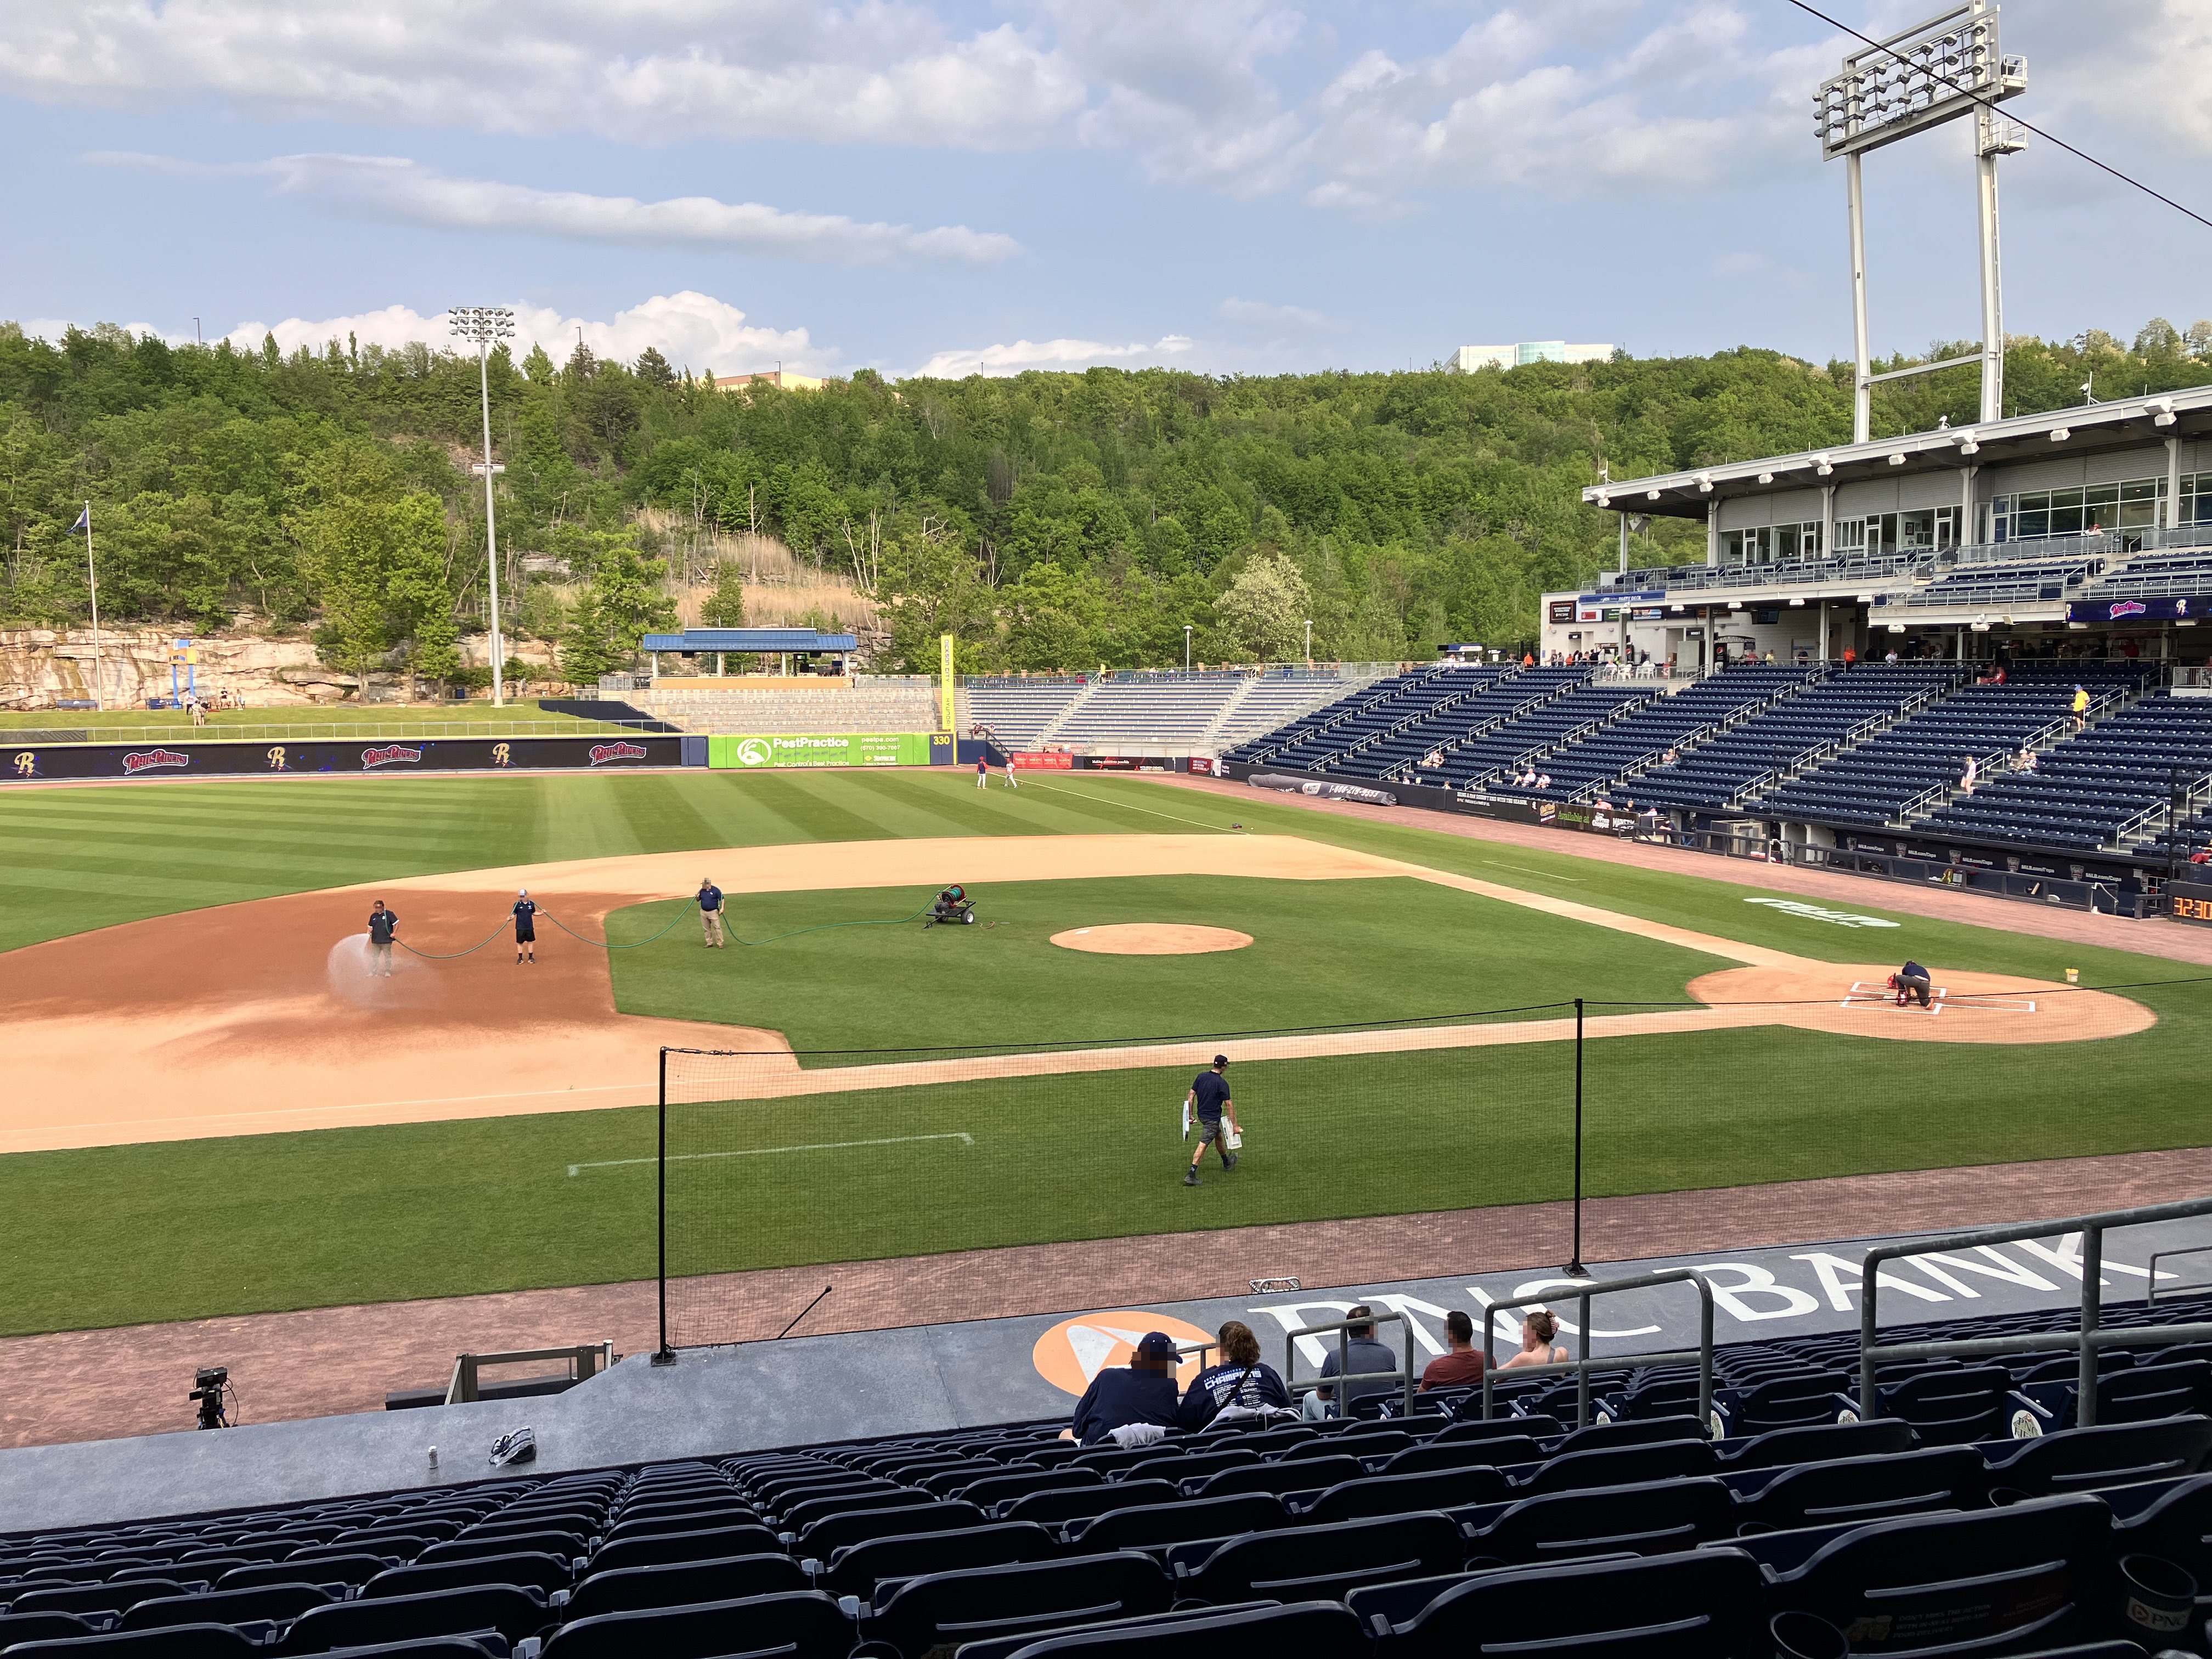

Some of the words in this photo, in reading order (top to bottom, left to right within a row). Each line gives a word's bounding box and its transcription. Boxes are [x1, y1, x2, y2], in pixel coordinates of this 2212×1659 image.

[773, 737, 849, 748] PestPractice
[933, 735, 950, 746] 330
[14, 752, 35, 777] R
[267, 746, 286, 771] R
[493, 743, 510, 767] R
[787, 759, 812, 768] Control's
[1558, 810, 1583, 823] Available
[1583, 816, 1590, 824] at
[2174, 896, 2212, 921] 32:30
[1247, 1278, 1662, 1369] PNC
[1652, 1231, 2180, 1322] BANK
[1204, 1370, 1262, 1390] CHAMPINS
[2151, 1612, 2187, 1627] PNC
